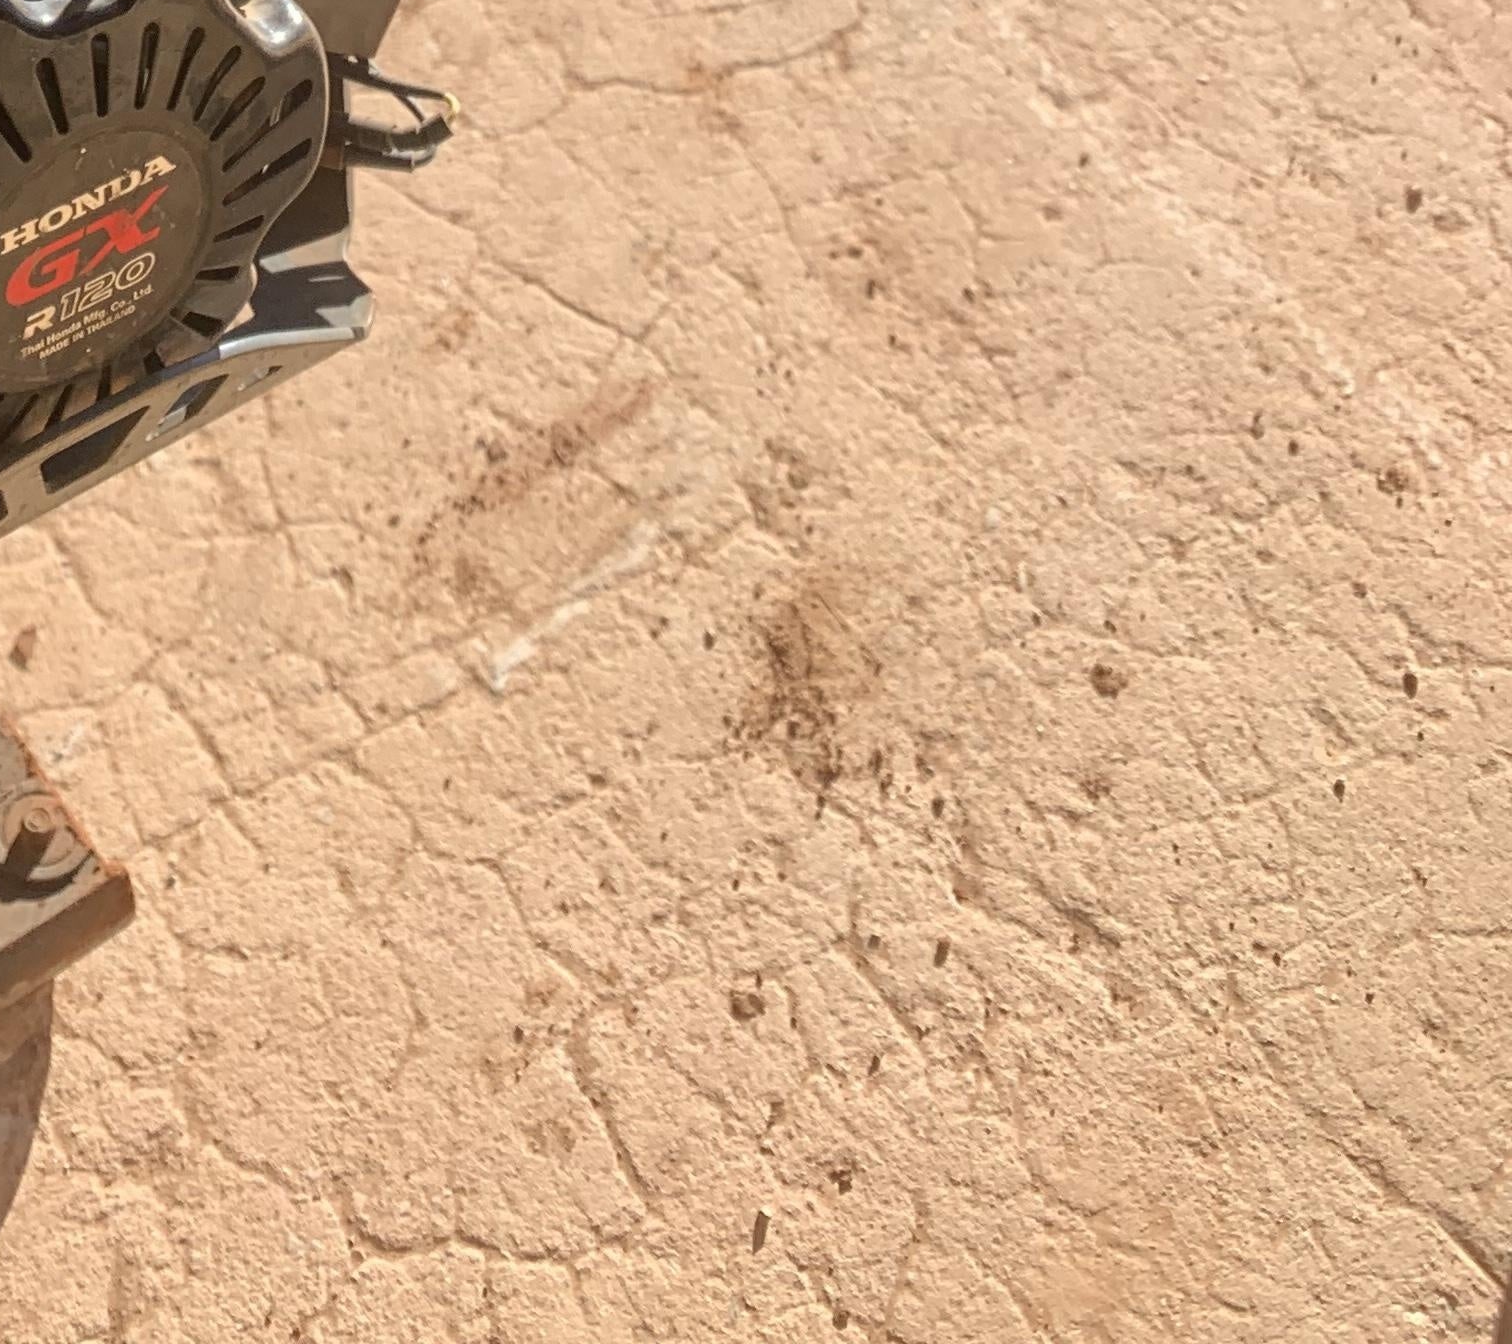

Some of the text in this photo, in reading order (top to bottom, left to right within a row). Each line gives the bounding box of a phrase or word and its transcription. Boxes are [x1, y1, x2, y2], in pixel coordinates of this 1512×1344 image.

[0, 155, 177, 255] HONDA
[5, 184, 169, 306] GX
[20, 339, 46, 359] Thai
[46, 321, 82, 346] Honda
[39, 304, 136, 359] MADE IN THAILAND
